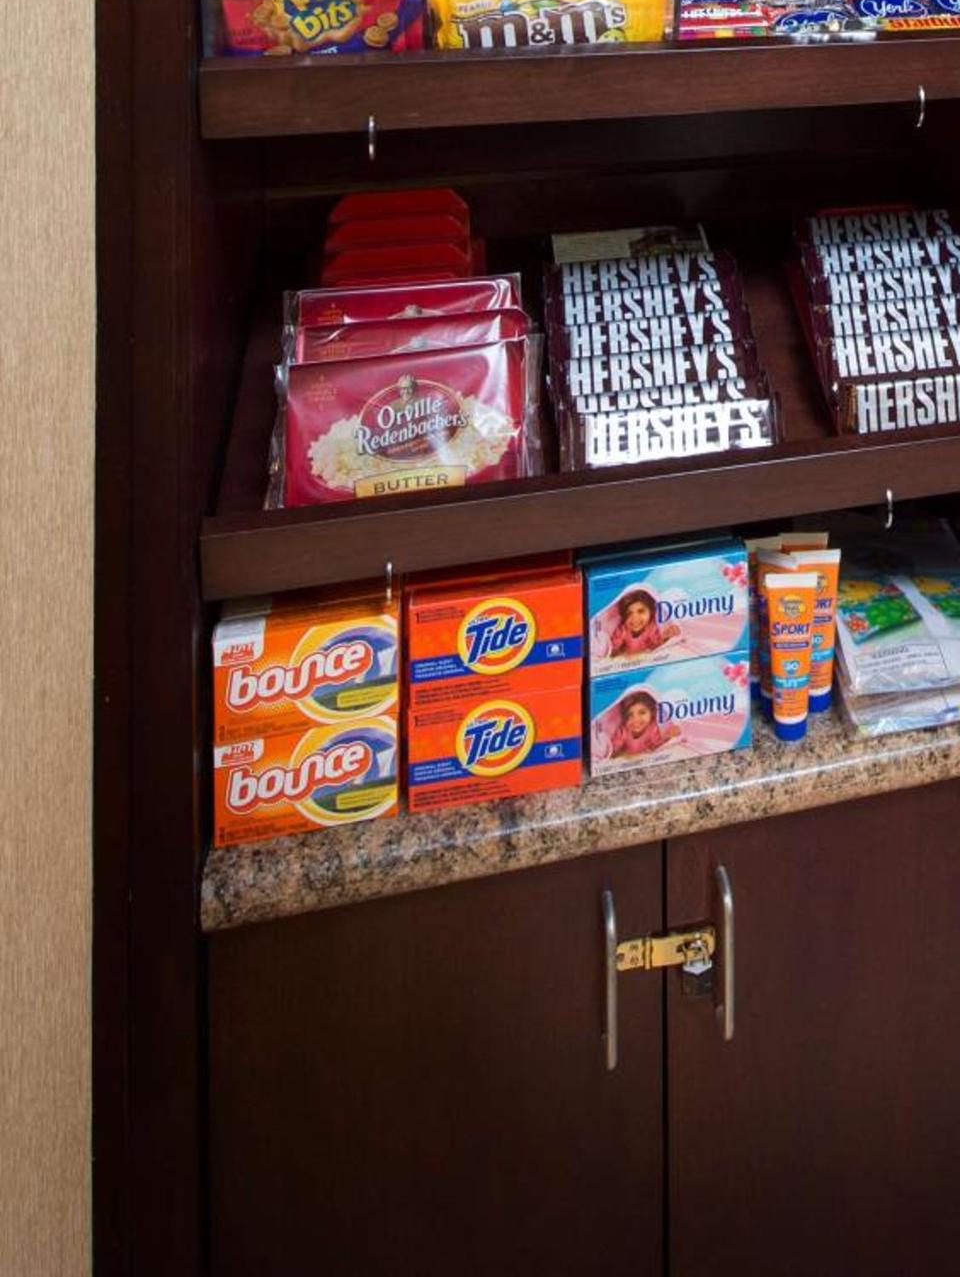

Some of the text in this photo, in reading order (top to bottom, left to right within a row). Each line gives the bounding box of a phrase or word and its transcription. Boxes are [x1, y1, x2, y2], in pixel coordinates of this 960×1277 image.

[293, 0, 351, 40] bits
[564, 280, 724, 326] HERSHEY'S
[570, 309, 734, 359] HERSHEY'S
[569, 342, 739, 396] HERSHEY'S
[353, 411, 469, 456] Redenbacher's
[377, 395, 444, 430] Orville
[586, 398, 774, 467] HERSHEY'S
[373, 473, 450, 495] BUTTER
[655, 593, 736, 625] Downy
[771, 622, 811, 636] SPORT
[464, 614, 530, 666] Tide
[228, 642, 368, 708] bounce
[656, 692, 737, 725] Downy
[462, 719, 528, 770] Tide
[228, 744, 367, 810] bounce
